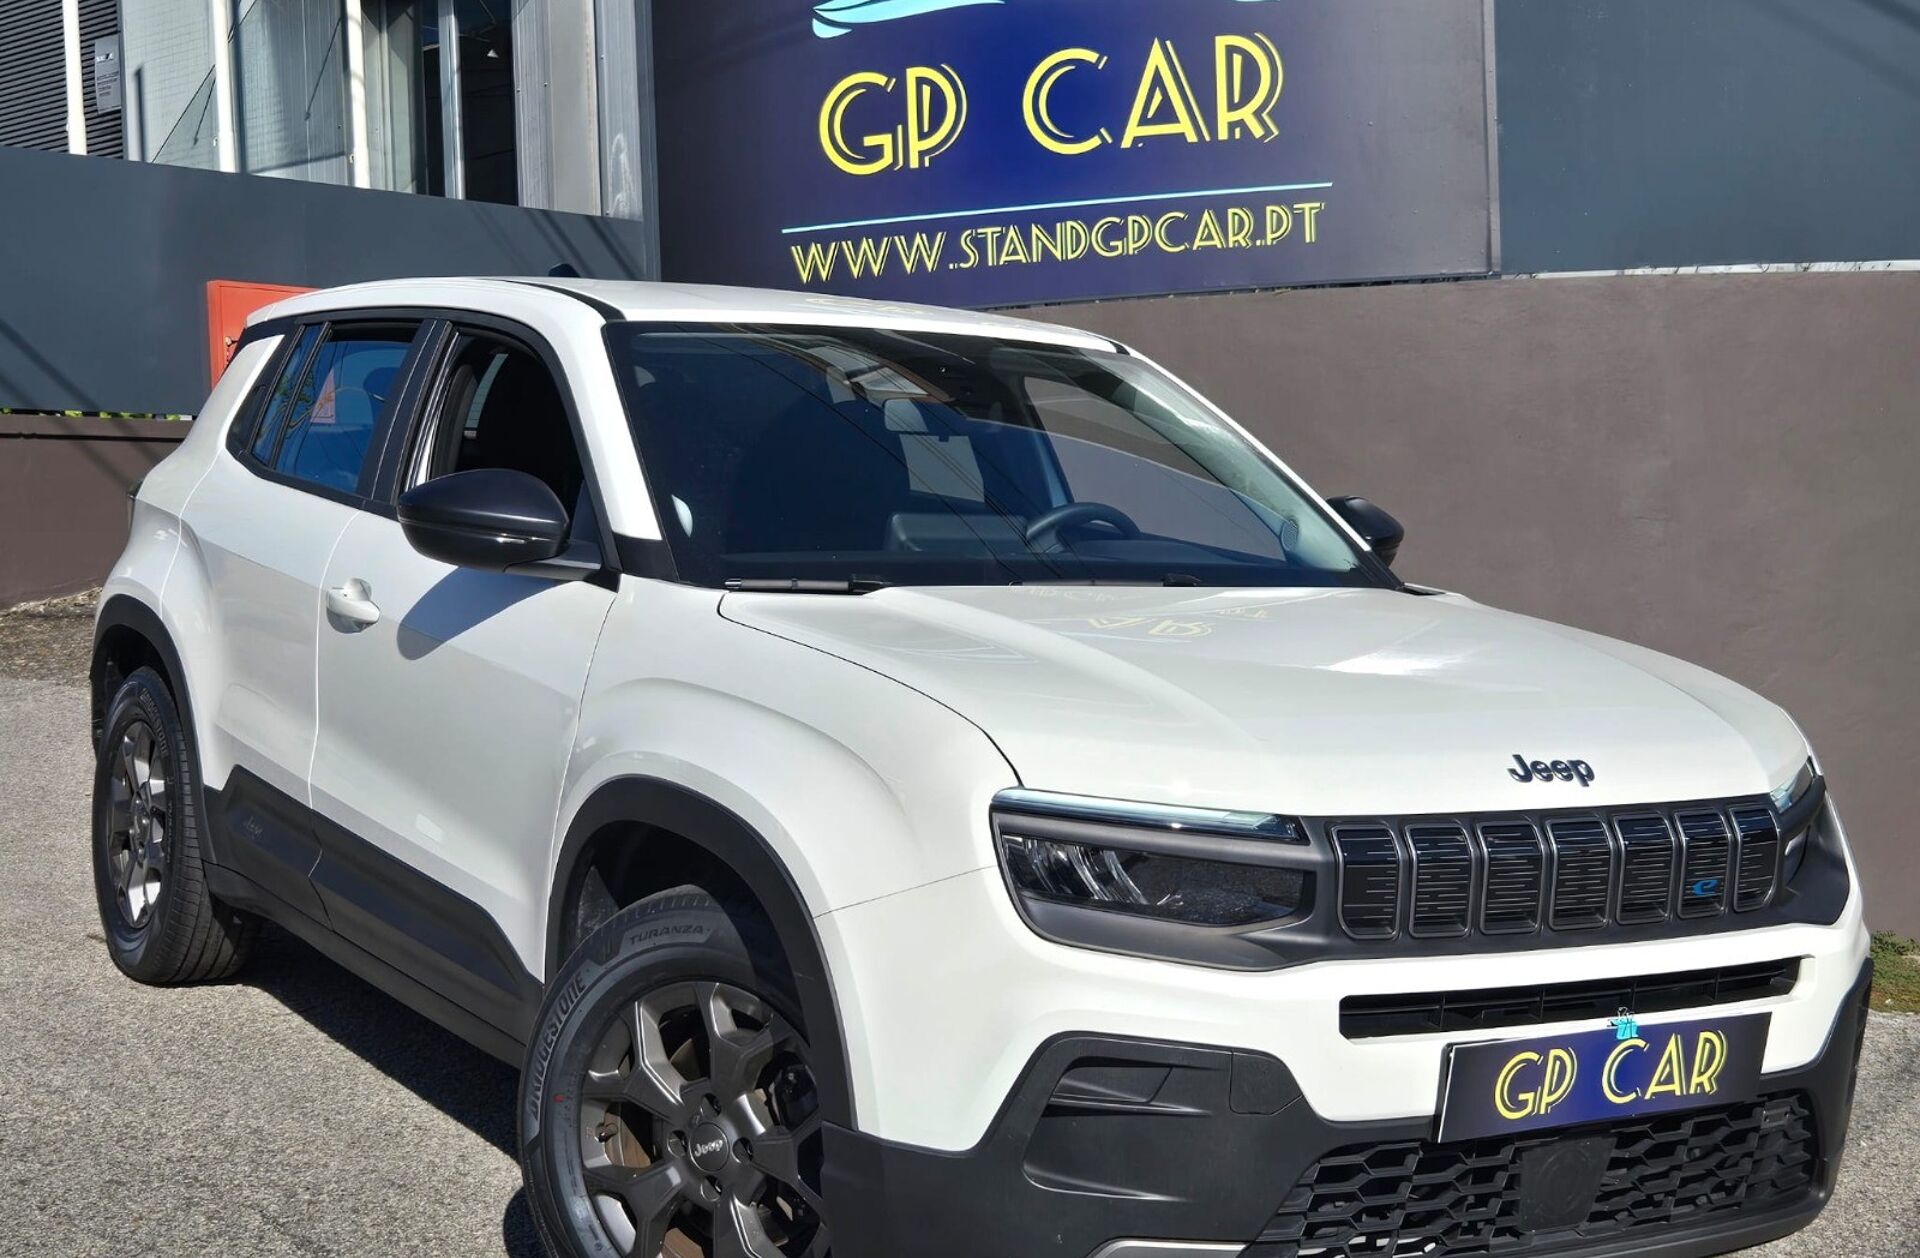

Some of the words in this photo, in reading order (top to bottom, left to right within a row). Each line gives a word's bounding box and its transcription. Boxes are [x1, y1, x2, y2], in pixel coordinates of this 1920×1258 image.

[818, 64, 967, 175] GP
[1022, 32, 1284, 155] CAR
[791, 203, 1325, 285] WWW.STANDGPCAR.PT
[1507, 754, 1595, 787] Jeep
[629, 925, 704, 945] TURANZA
[1494, 1049, 1577, 1120] GP
[1602, 1031, 1727, 1104] CAR
[694, 1139, 723, 1157] Jeep
